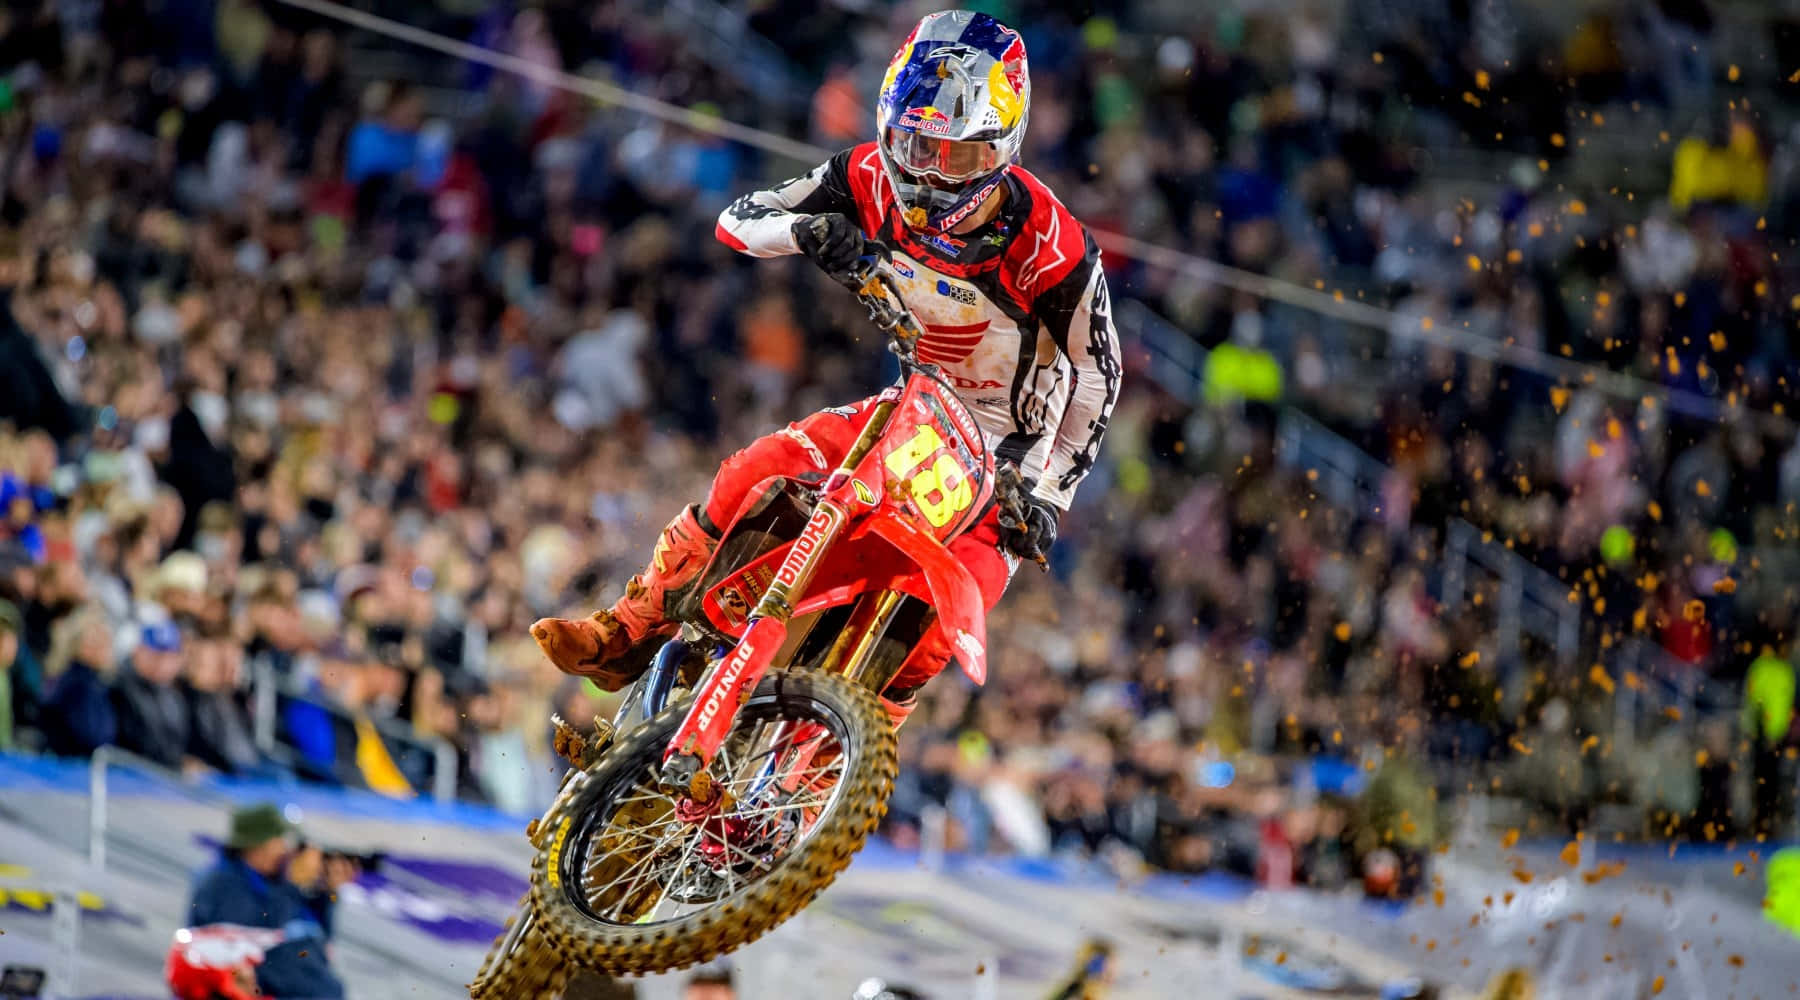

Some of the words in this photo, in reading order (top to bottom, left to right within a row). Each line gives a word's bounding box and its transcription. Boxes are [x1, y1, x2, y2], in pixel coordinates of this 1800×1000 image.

[899, 116, 924, 129] Red
[924, 120, 950, 134] Bull
[885, 423, 973, 528] 18
[777, 510, 833, 588] SHOWA
[697, 640, 755, 732] DUNLOP
